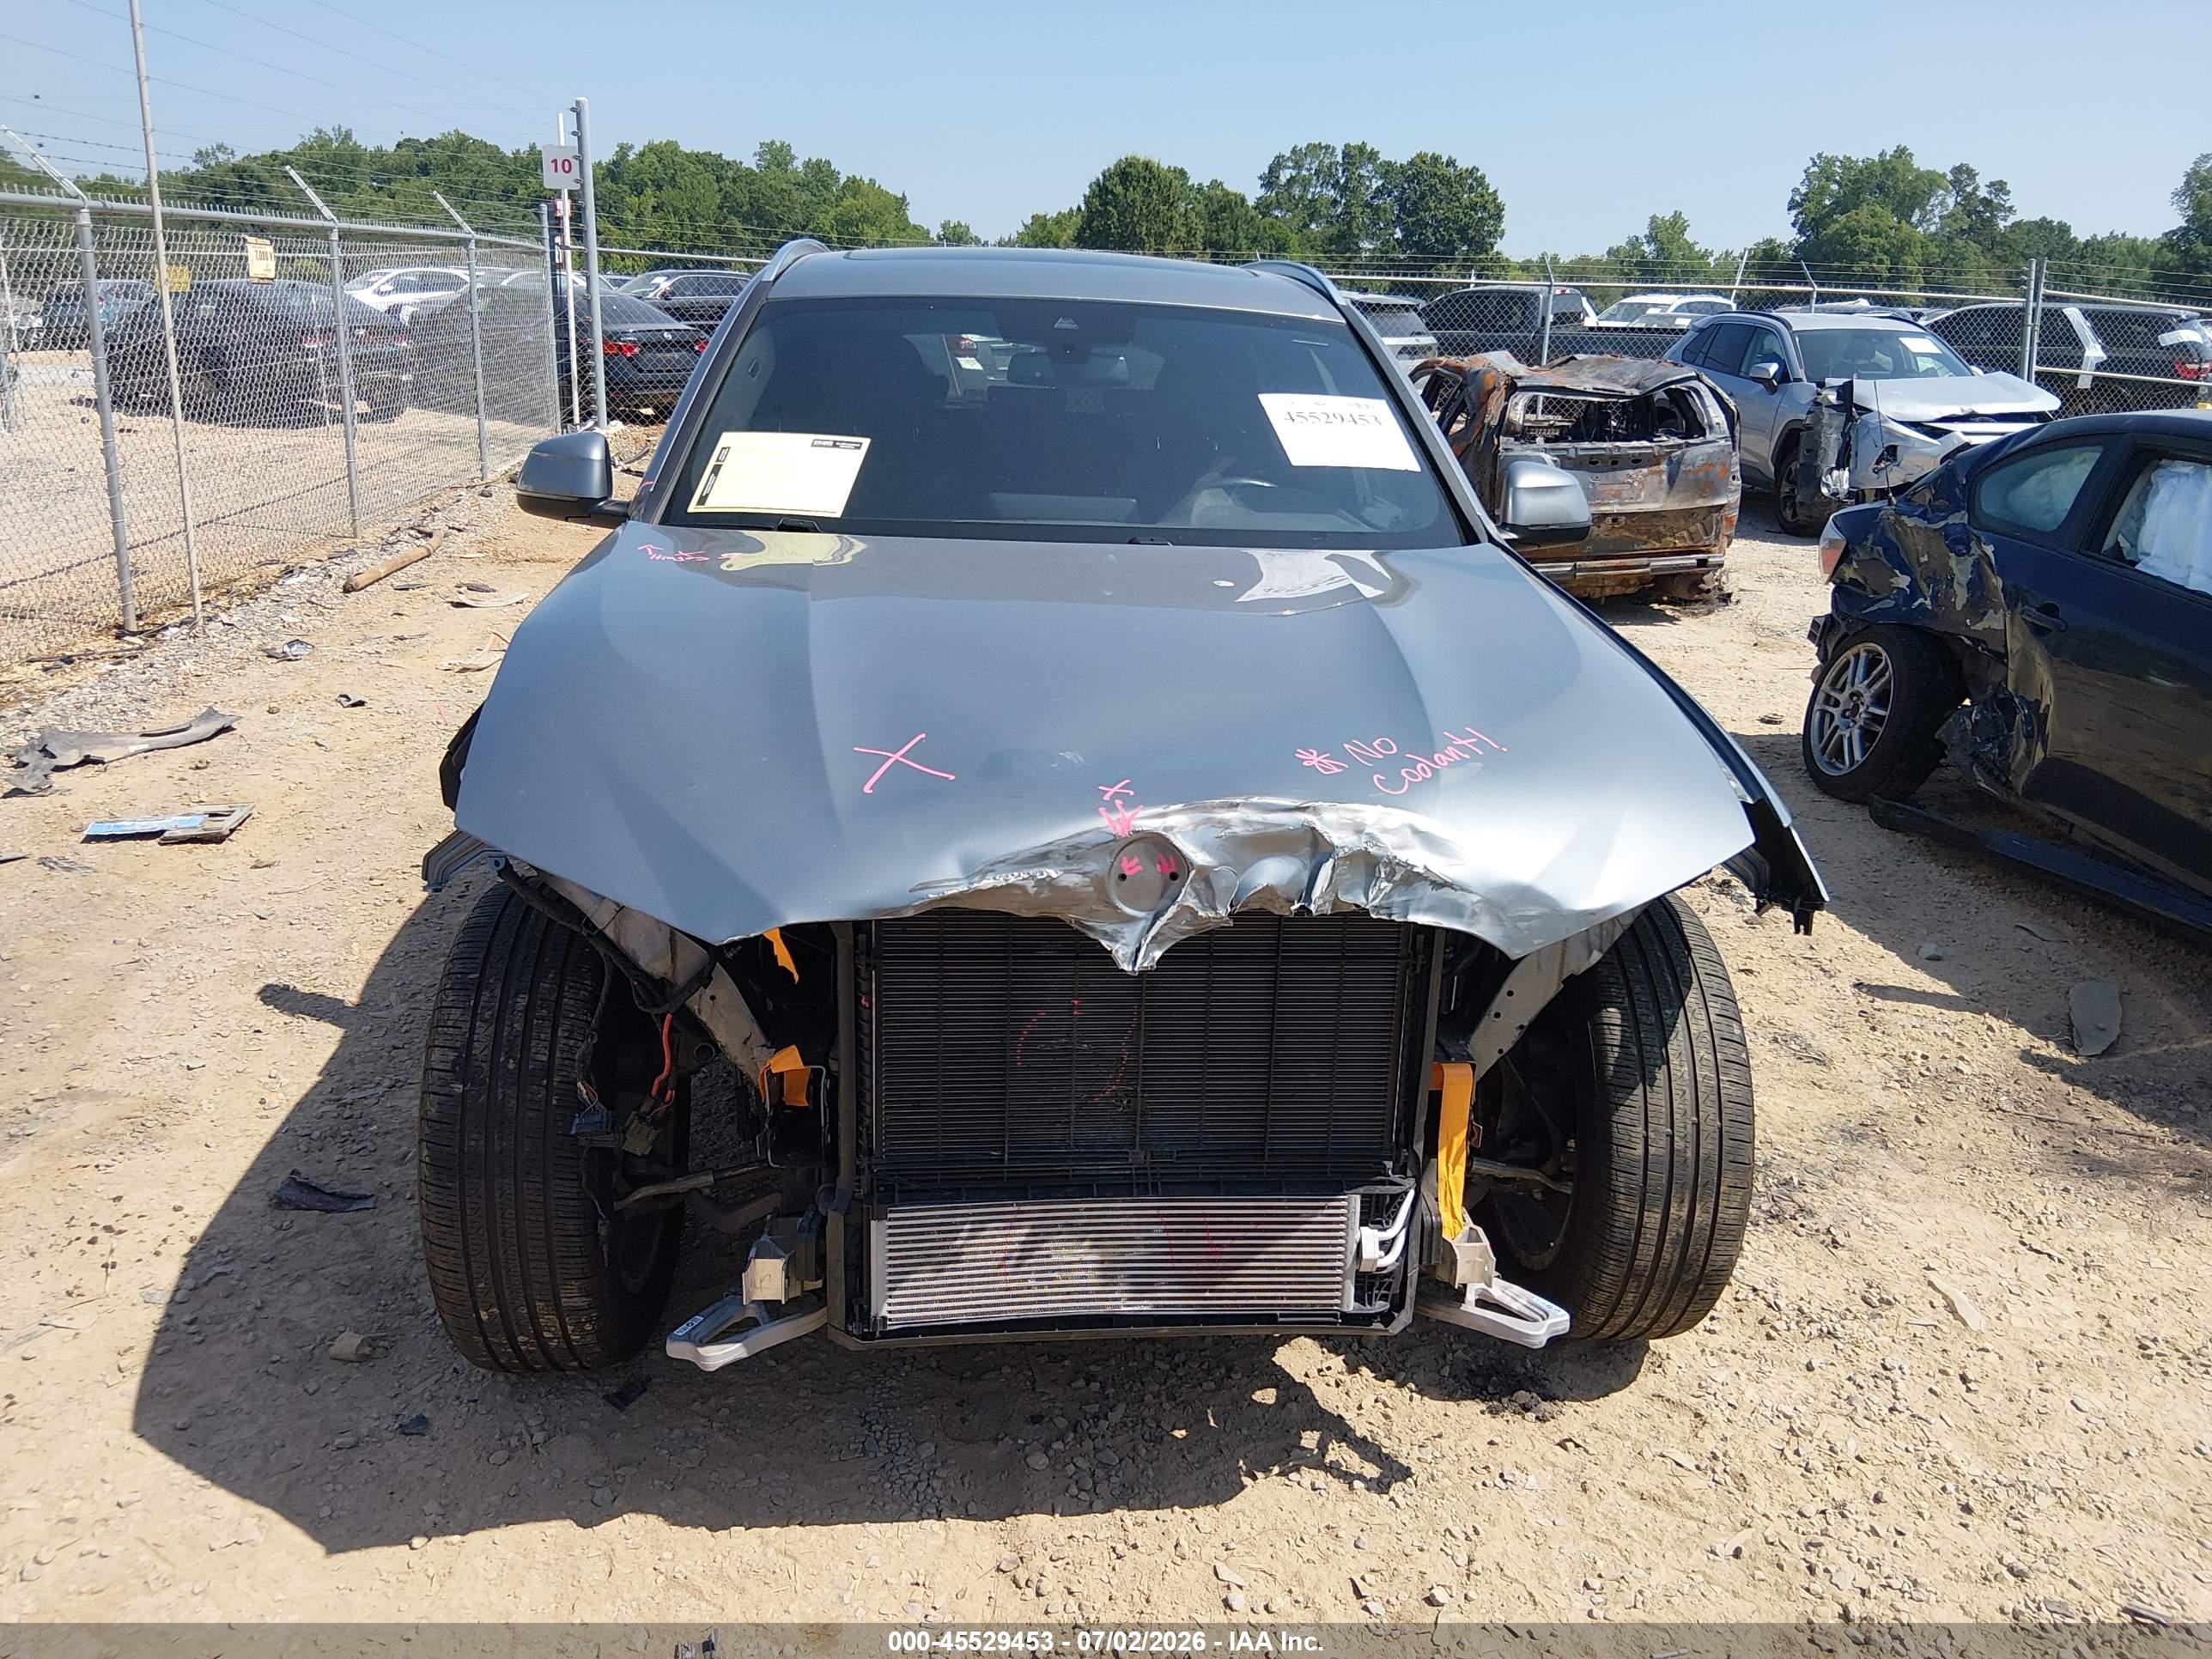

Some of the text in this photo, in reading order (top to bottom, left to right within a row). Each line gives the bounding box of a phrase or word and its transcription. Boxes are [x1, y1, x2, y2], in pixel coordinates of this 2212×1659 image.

[550, 158, 573, 174] 10
[1284, 410, 1382, 427] 45529453
[1341, 737, 1399, 767] No
